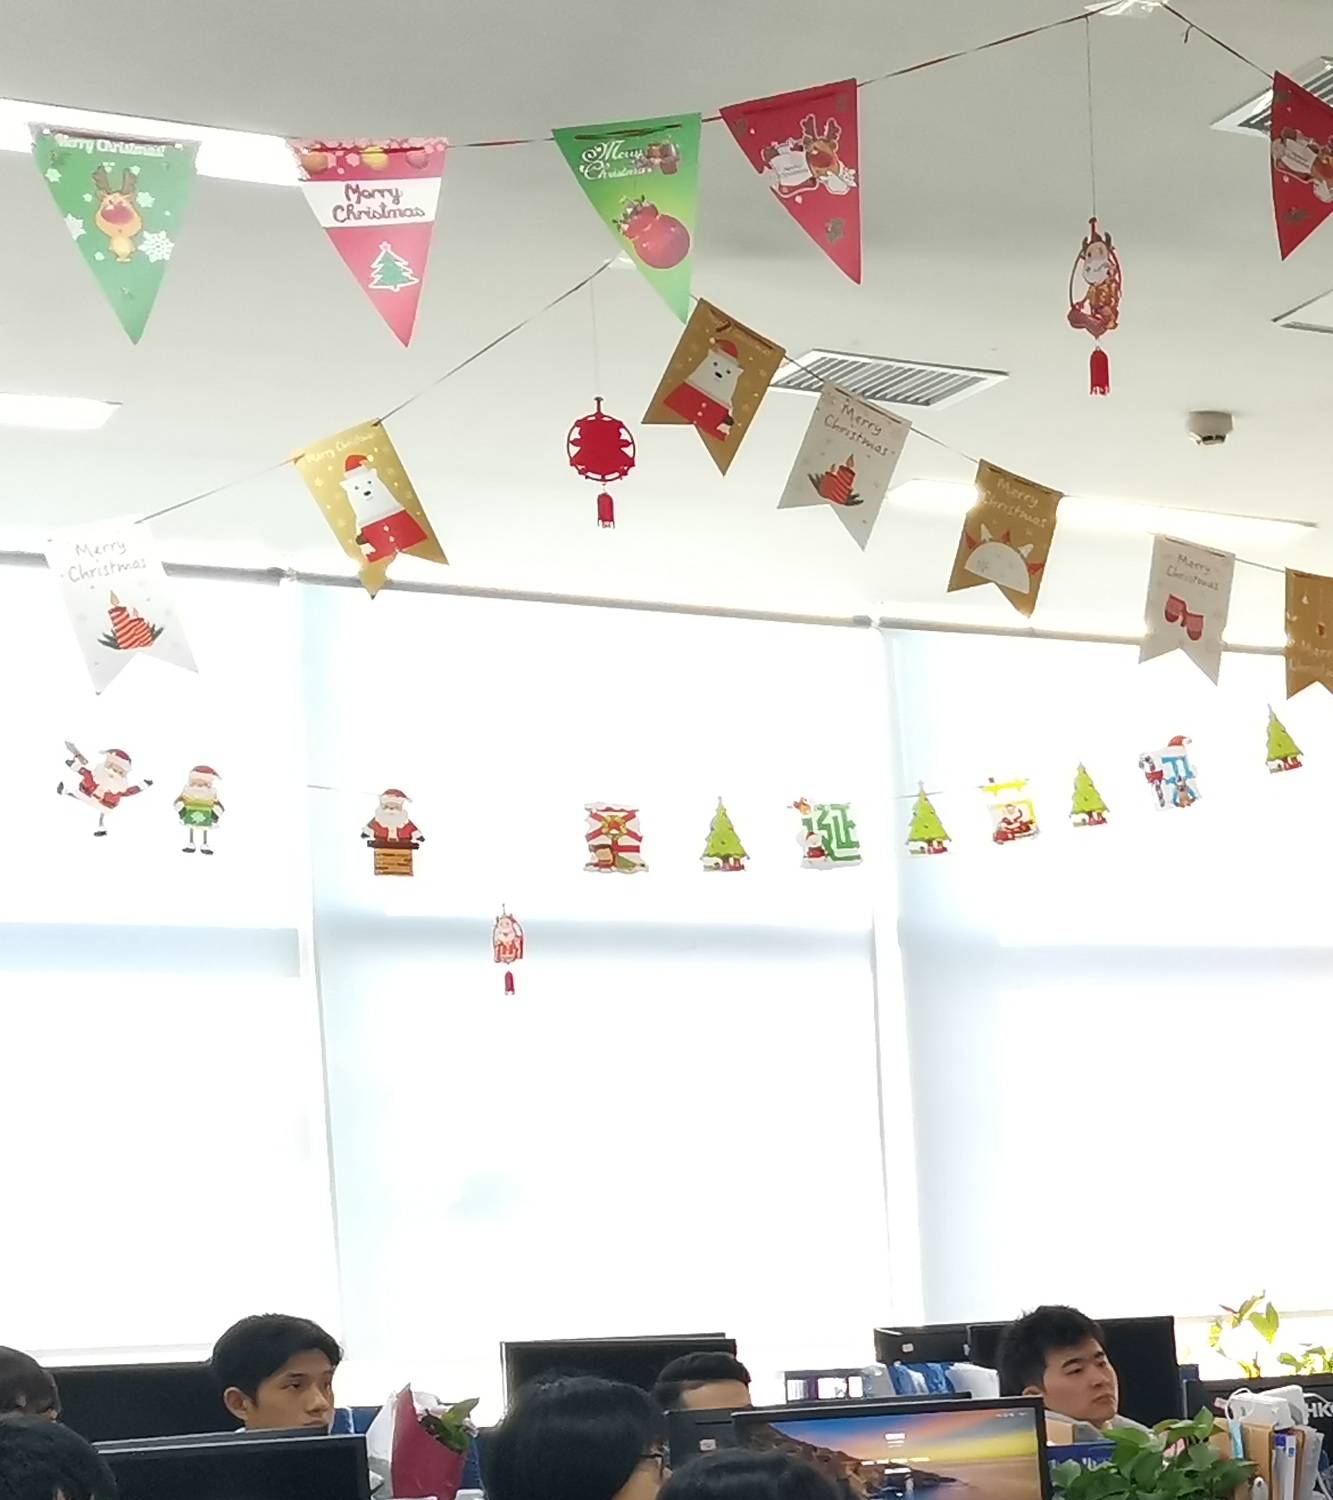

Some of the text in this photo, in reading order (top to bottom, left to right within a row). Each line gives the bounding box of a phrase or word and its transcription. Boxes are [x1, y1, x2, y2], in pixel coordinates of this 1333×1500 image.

[344, 182, 402, 206] Merry
[332, 203, 426, 223] Christmas
[840, 401, 883, 437] Merry
[823, 414, 890, 457] Christmas
[998, 477, 1039, 508] Merry
[75, 538, 128, 561] Merry
[67, 556, 147, 584] Christmas
